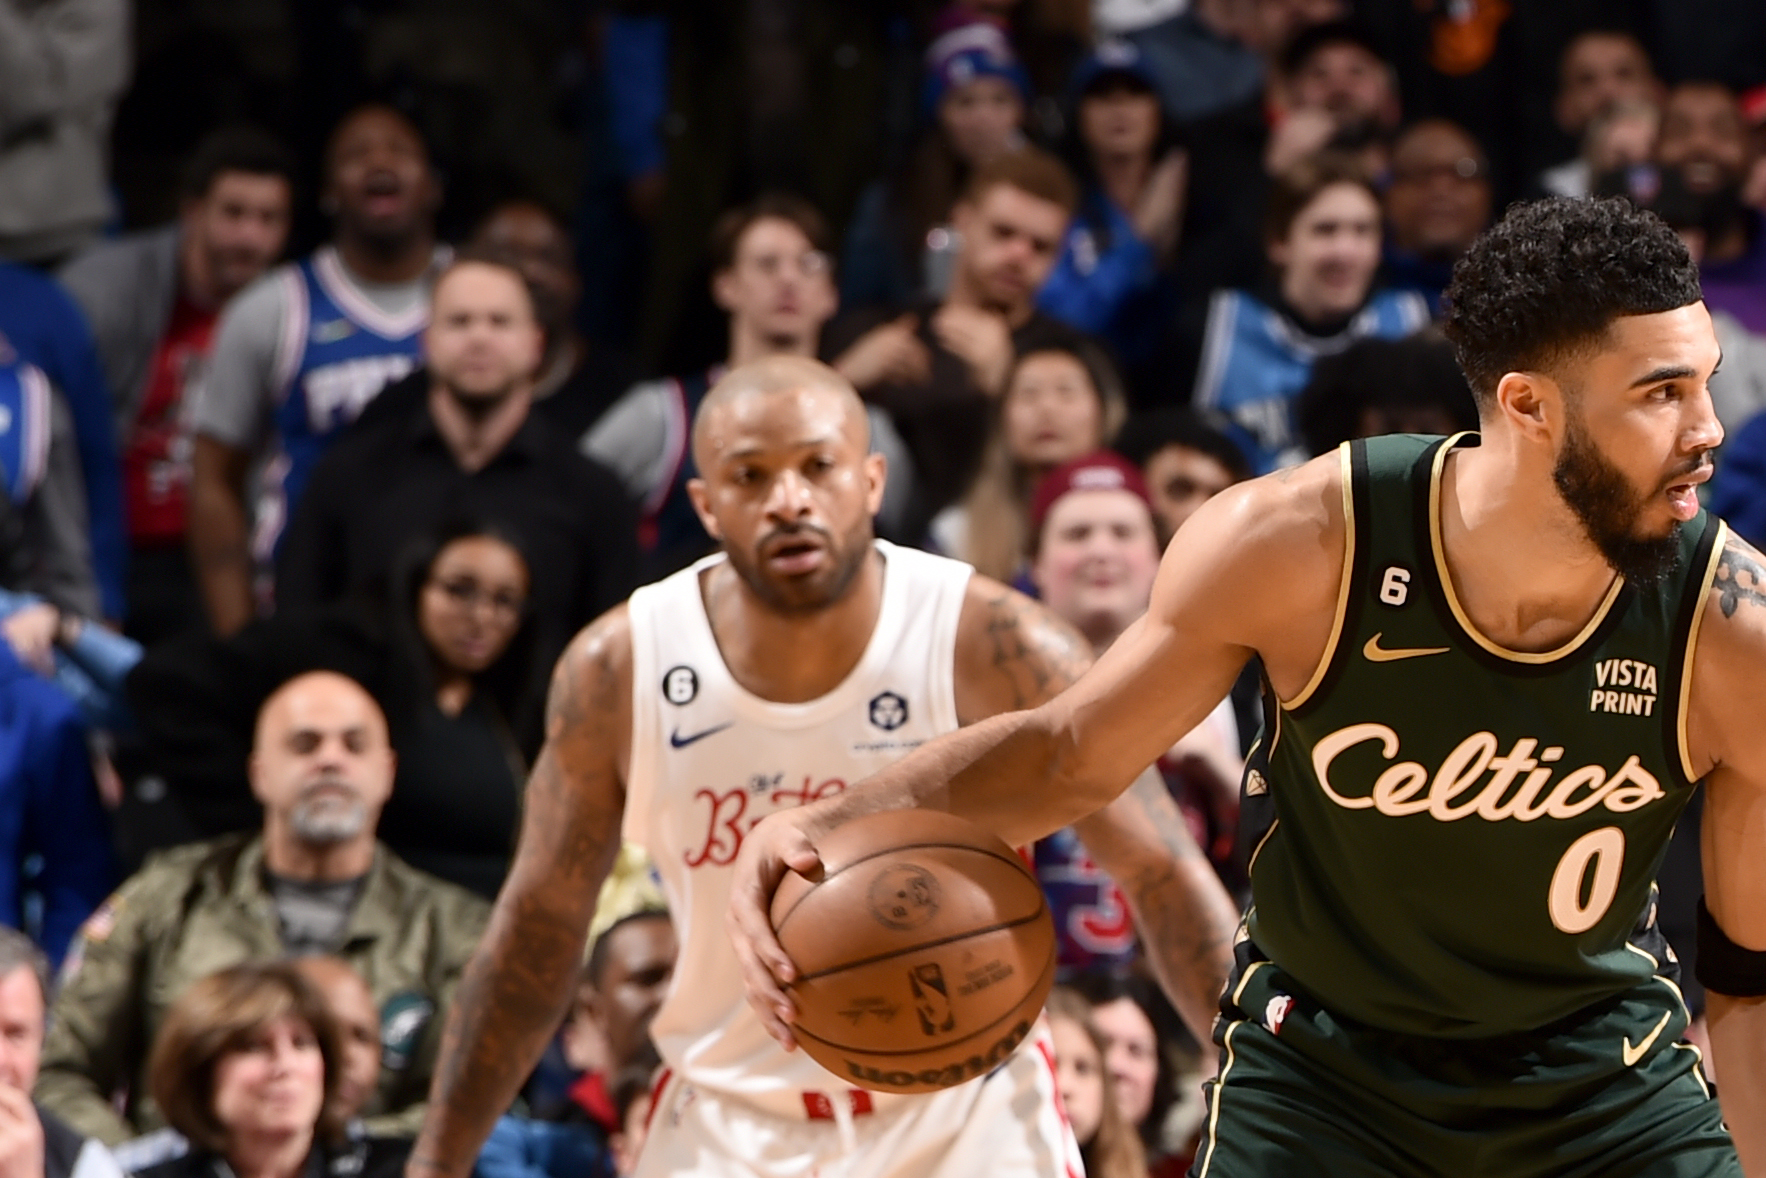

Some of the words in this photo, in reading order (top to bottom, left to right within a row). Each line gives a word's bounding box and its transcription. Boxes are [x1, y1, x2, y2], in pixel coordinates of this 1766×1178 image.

[1379, 566, 1411, 607] 6
[668, 669, 694, 702] 6
[1594, 658, 1658, 695] VISTA
[1589, 690, 1658, 717] PRINT
[1311, 722, 1666, 822] Celtics
[1547, 826, 1625, 935] 0
